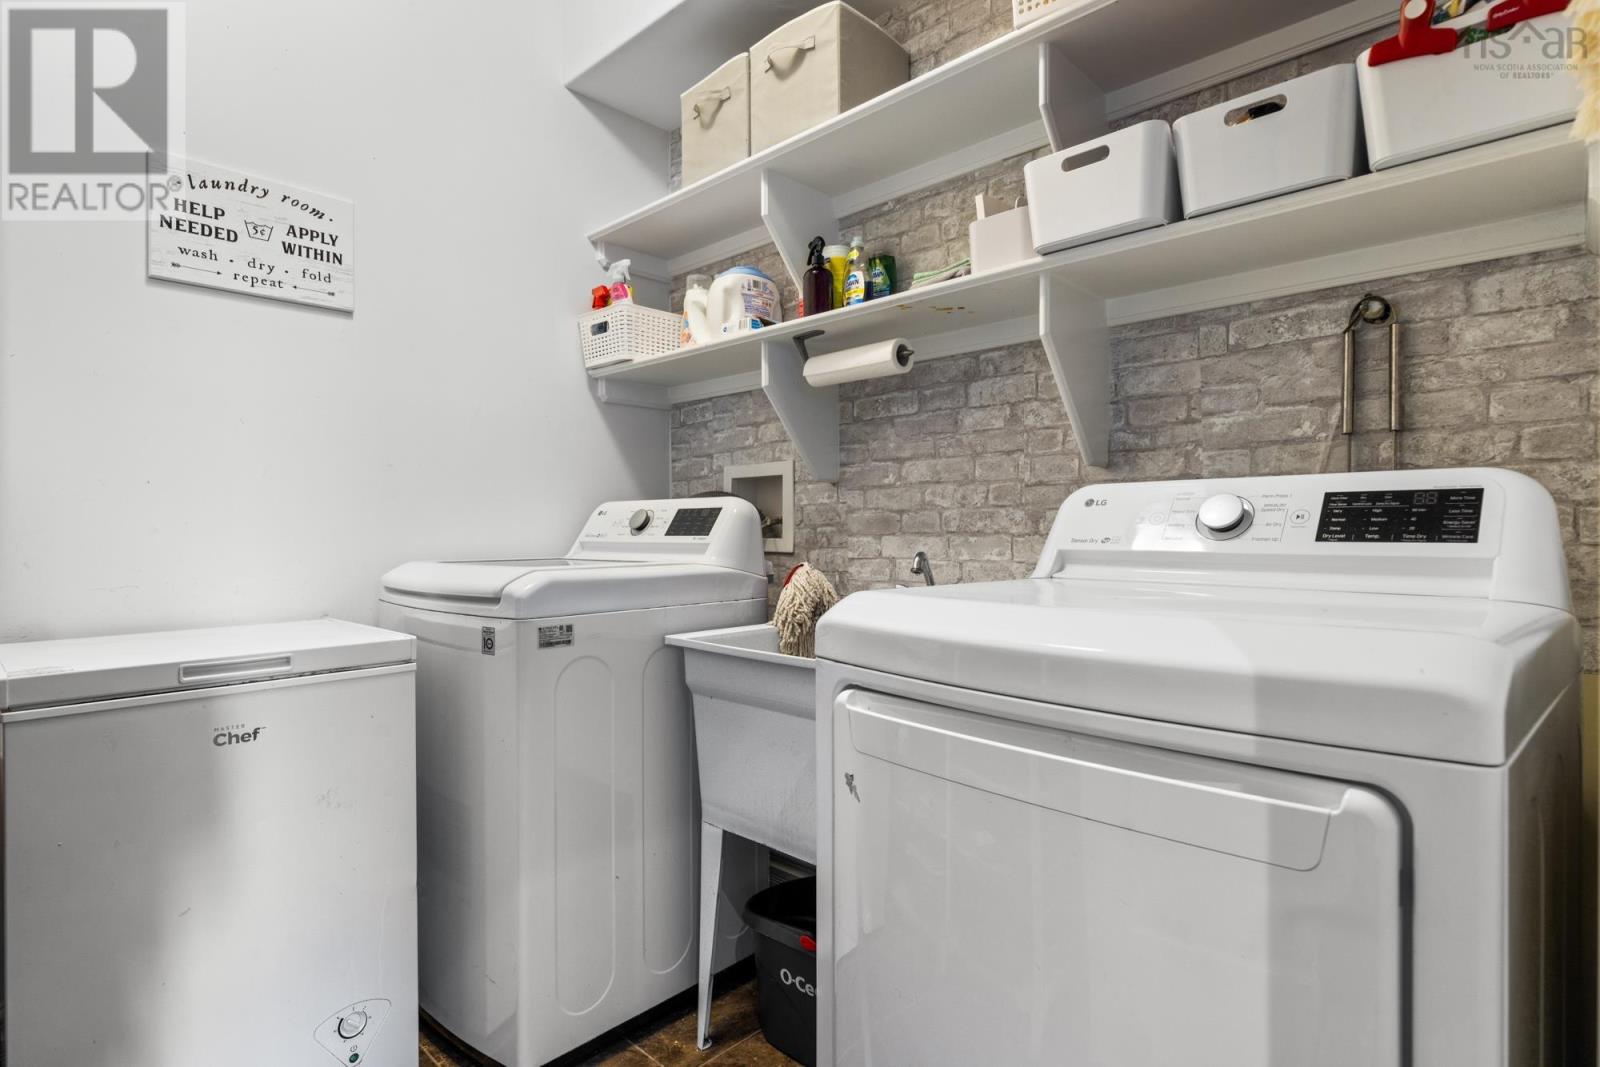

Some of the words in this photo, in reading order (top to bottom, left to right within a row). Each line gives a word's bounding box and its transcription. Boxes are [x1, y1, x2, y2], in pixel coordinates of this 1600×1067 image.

[187, 174, 270, 199] laundry
[173, 197, 226, 221] HELP
[159, 214, 239, 243] NEEDED
[286, 224, 339, 247] APPLY
[177, 246, 218, 261] wash
[247, 257, 275, 275] dry
[301, 268, 332, 284] fold
[281, 240, 344, 266] WITHIN
[233, 272, 284, 288] repeat
[213, 727, 261, 747] Chef
[780, 968, 816, 997] O-Ce
